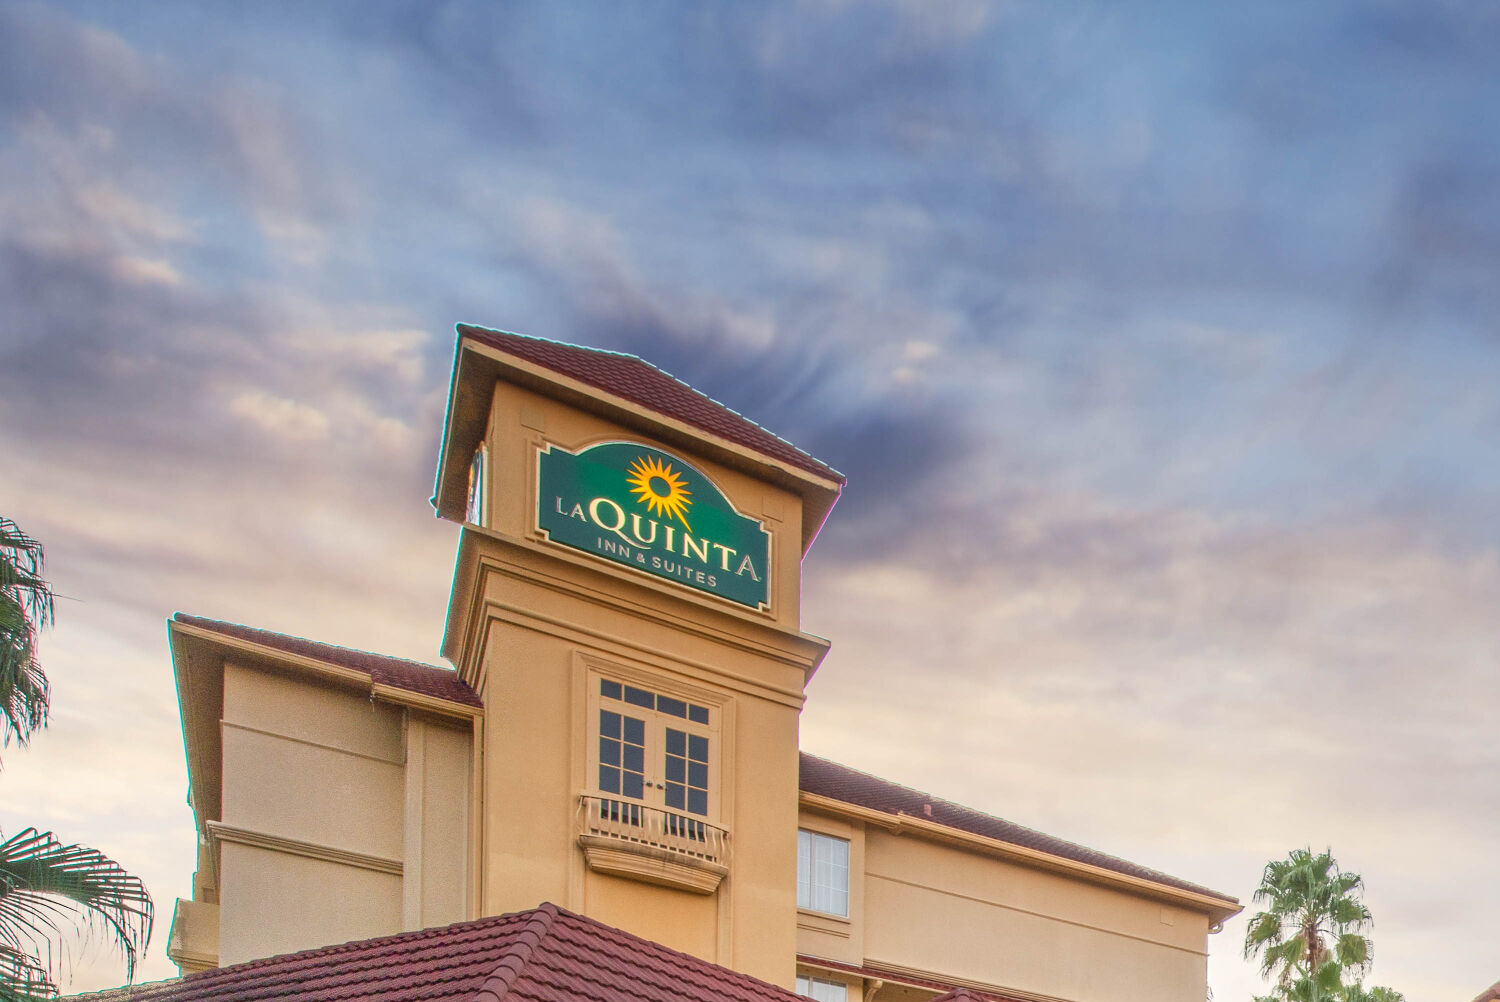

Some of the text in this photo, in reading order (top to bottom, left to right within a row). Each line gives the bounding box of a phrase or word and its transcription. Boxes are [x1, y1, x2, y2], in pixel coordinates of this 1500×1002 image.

[556, 496, 760, 582] LA QUINTA
[597, 537, 717, 587] INN & SUITES
